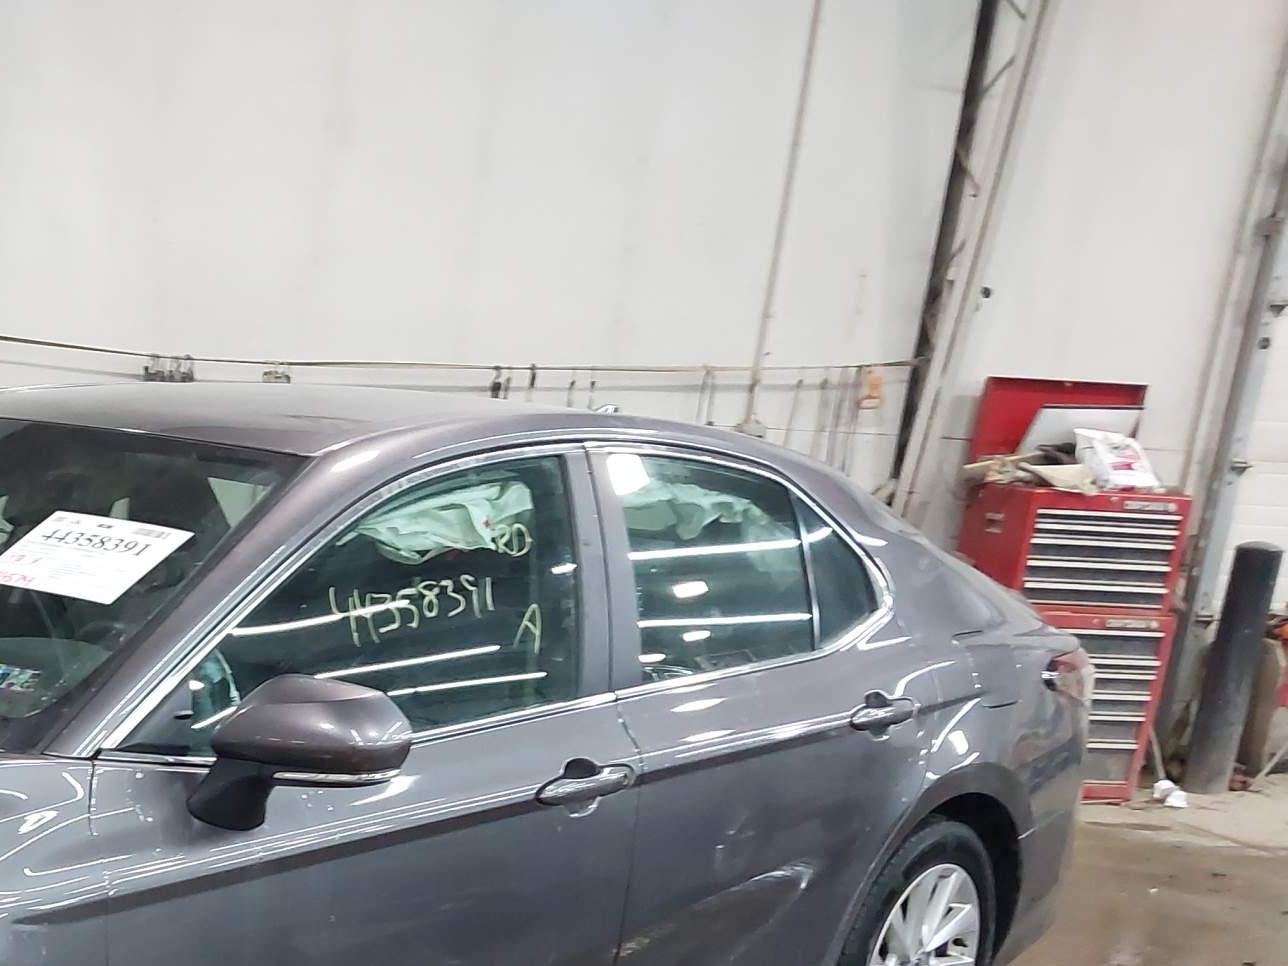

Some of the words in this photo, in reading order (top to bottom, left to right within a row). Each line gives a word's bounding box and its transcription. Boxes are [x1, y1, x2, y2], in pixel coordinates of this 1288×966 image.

[41, 528, 153, 557] 44358391
[328, 573, 496, 648] 44358391
[513, 602, 543, 656] A
